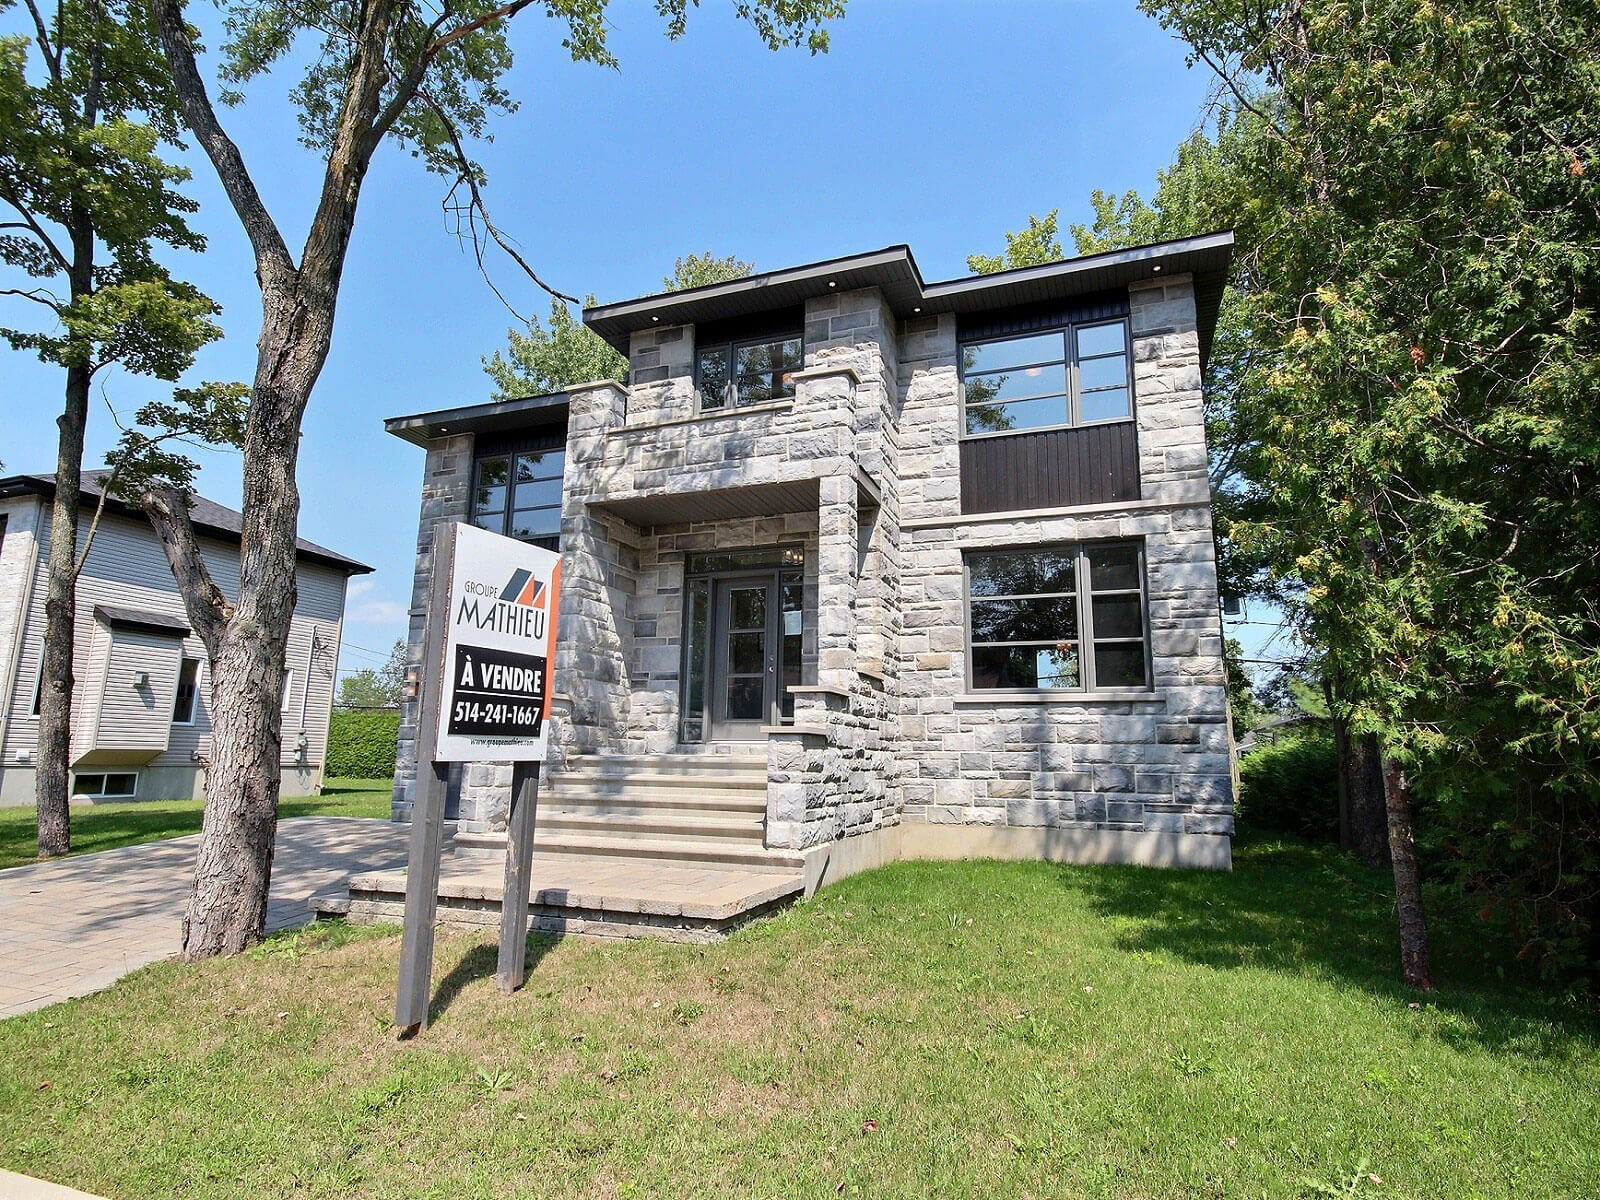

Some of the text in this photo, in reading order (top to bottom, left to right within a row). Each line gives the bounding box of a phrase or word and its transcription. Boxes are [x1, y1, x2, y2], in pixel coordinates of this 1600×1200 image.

[465, 581, 498, 599] GROUPE
[457, 595, 545, 639] MATHIEU
[460, 655, 542, 693] À VENDRE
[454, 701, 540, 725] 514-241-1667
